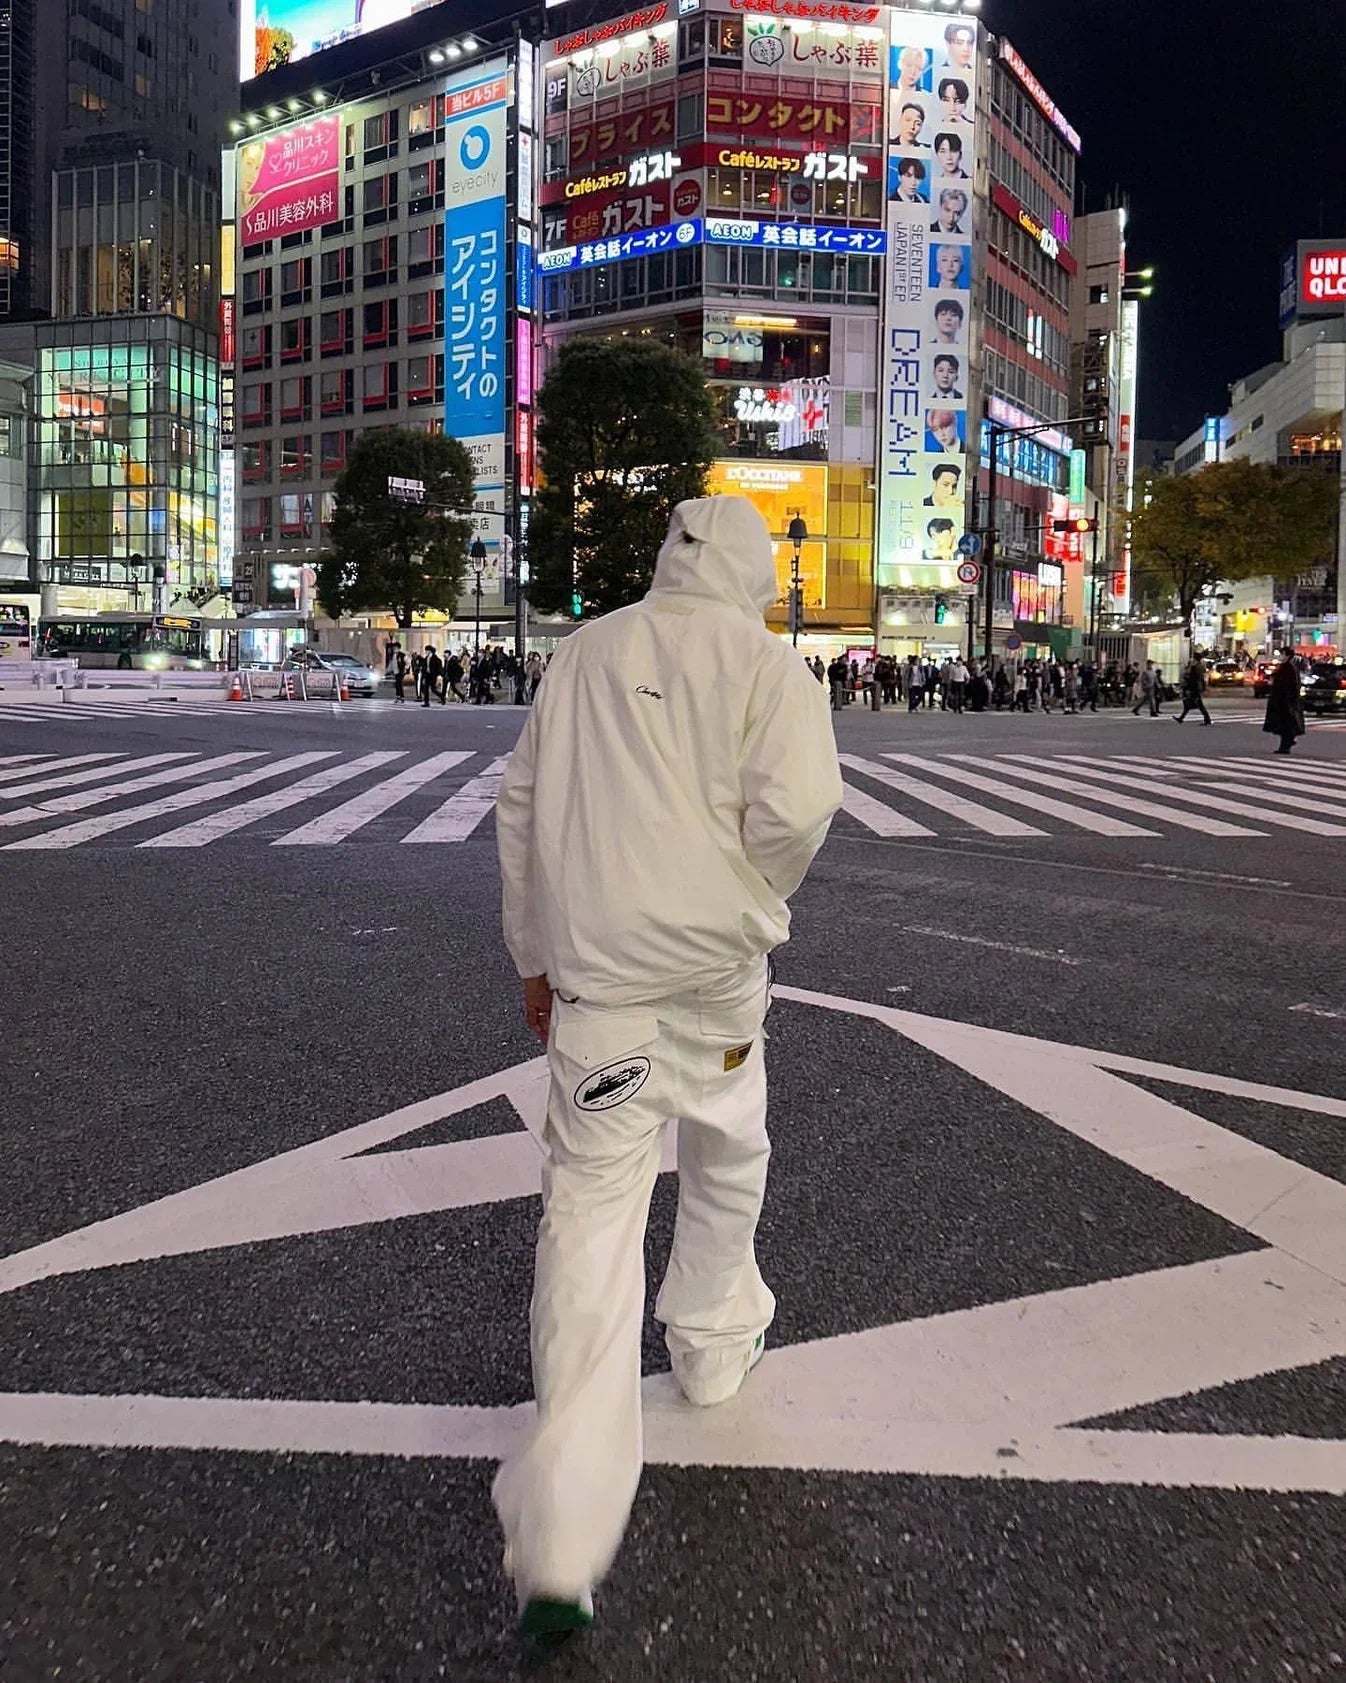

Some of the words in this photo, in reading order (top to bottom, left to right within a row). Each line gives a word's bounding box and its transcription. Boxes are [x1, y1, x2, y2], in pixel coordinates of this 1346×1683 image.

[606, 39, 670, 81] しゃぶ葉
[793, 34, 879, 67] しゃぶ葉
[548, 78, 566, 98] 9F
[708, 98, 845, 134] コンタクト
[283, 129, 334, 158] 品川スキン
[284, 149, 328, 177] クリニック
[628, 151, 682, 188] ガスト
[803, 152, 868, 181] ガスト
[452, 171, 498, 194] eyecity
[254, 191, 333, 233] 品川美容外科
[602, 195, 664, 237] ガスト
[545, 221, 567, 241] 7F
[712, 223, 752, 239] AEON
[763, 226, 882, 249] 英会話イーオン
[896, 222, 908, 267] JAPAN
[543, 252, 571, 269] AEON
[581, 231, 672, 264] 英会話イーオン
[911, 224, 923, 302] SEVENTEEN
[895, 284, 907, 303] EP
[452, 235, 476, 400] アイシティ
[480, 230, 497, 397] コンタクトの
[889, 329, 920, 475] DREAM
